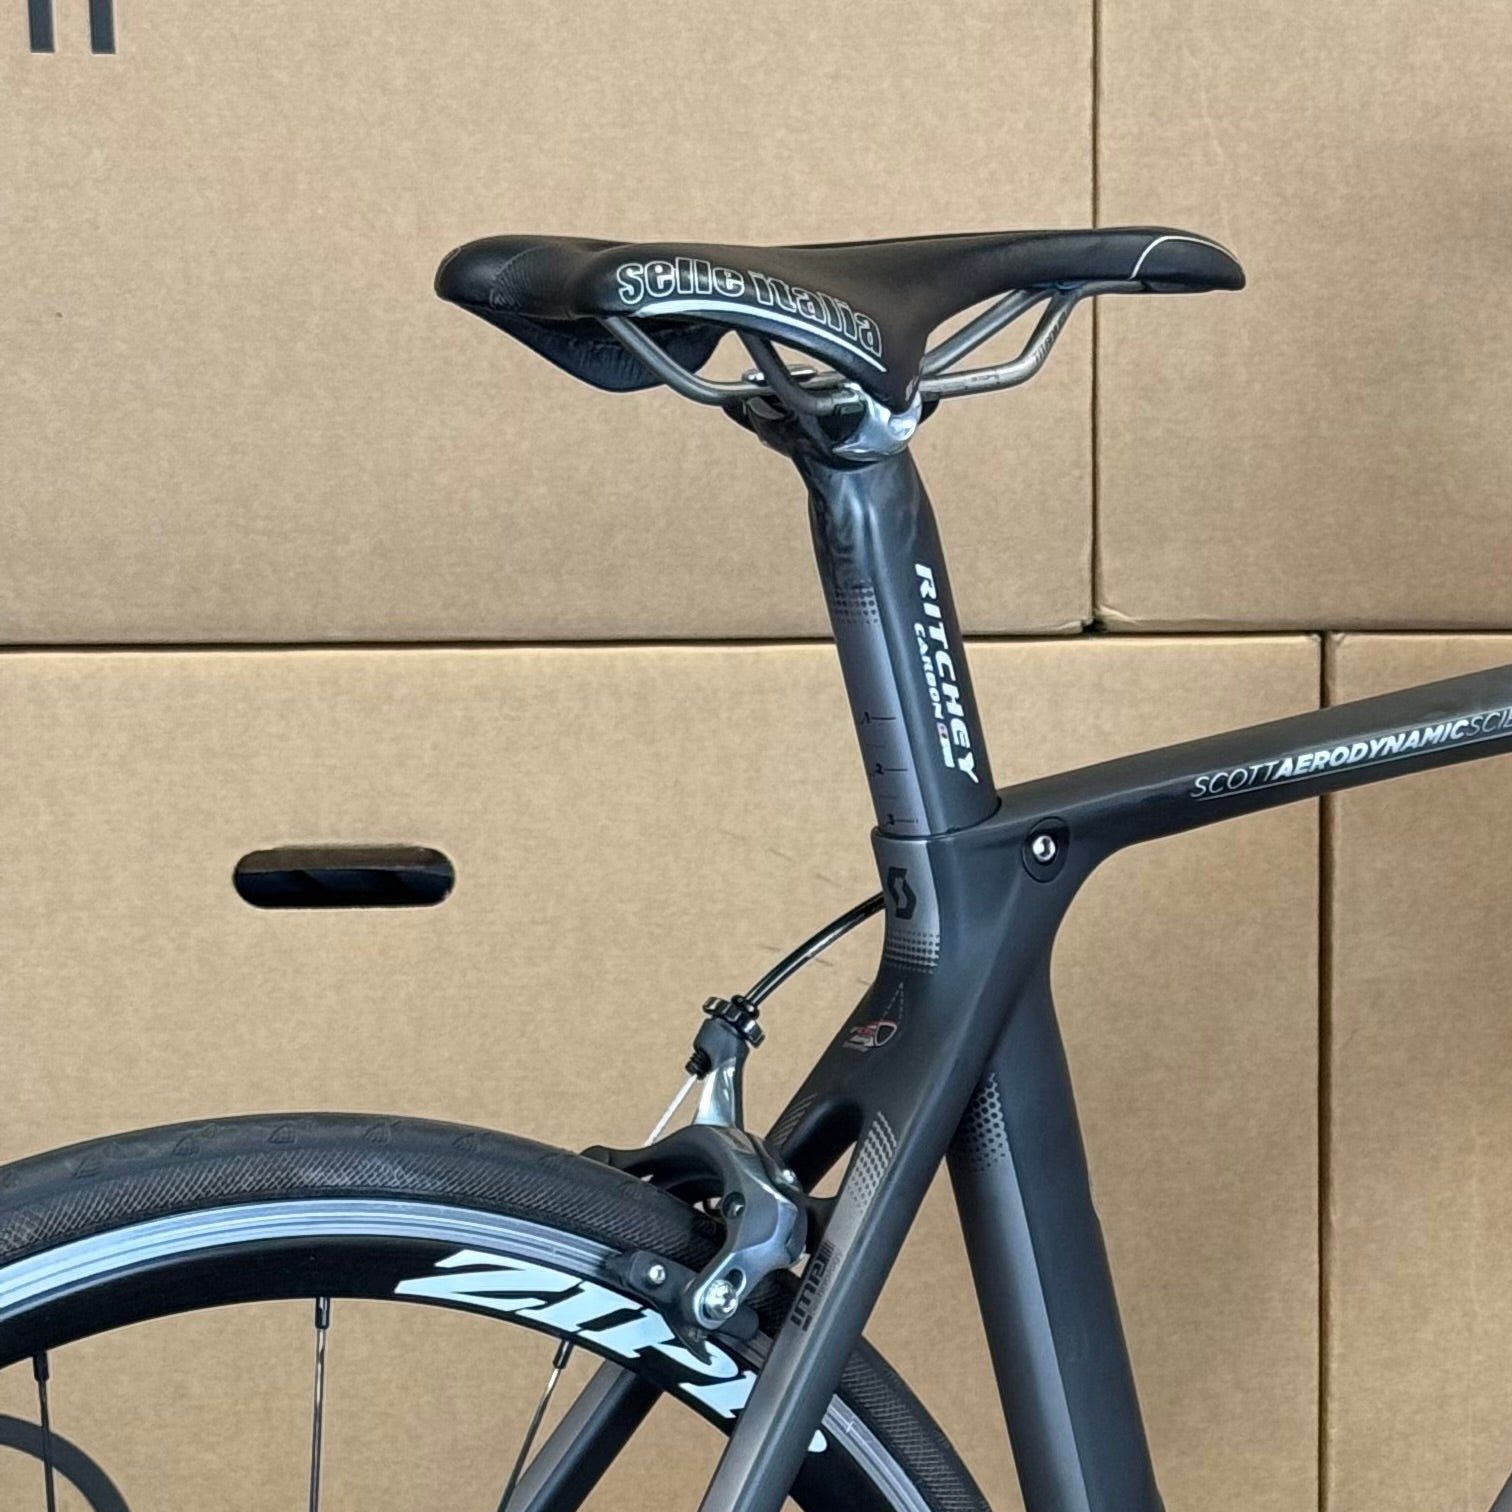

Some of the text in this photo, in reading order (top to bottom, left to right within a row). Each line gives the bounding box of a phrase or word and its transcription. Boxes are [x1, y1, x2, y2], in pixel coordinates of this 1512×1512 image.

[616, 256, 883, 358] selle italia
[914, 622, 945, 720] CARBON
[915, 563, 980, 784] RITCHEY
